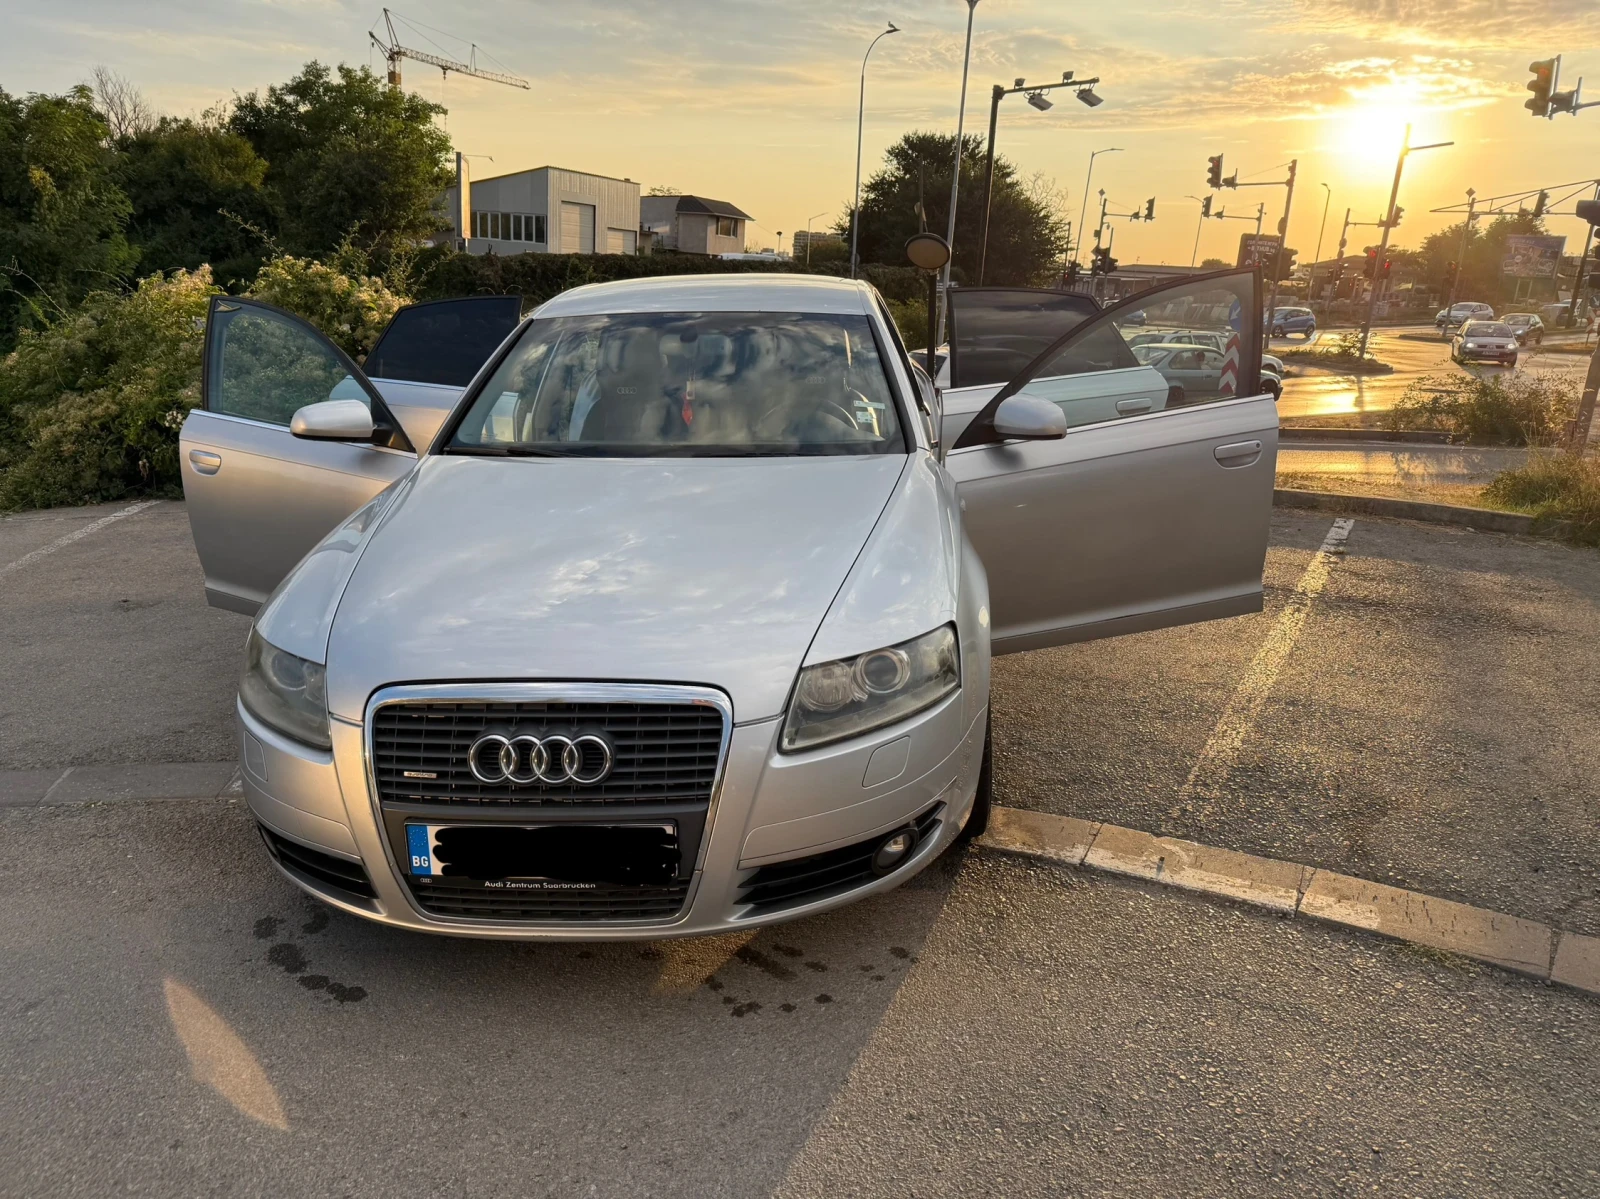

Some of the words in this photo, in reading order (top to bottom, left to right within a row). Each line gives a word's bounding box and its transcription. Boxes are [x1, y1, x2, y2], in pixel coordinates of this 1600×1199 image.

[412, 855, 429, 867] BG
[484, 880, 504, 888] Audi
[505, 881, 541, 889] Zentrum
